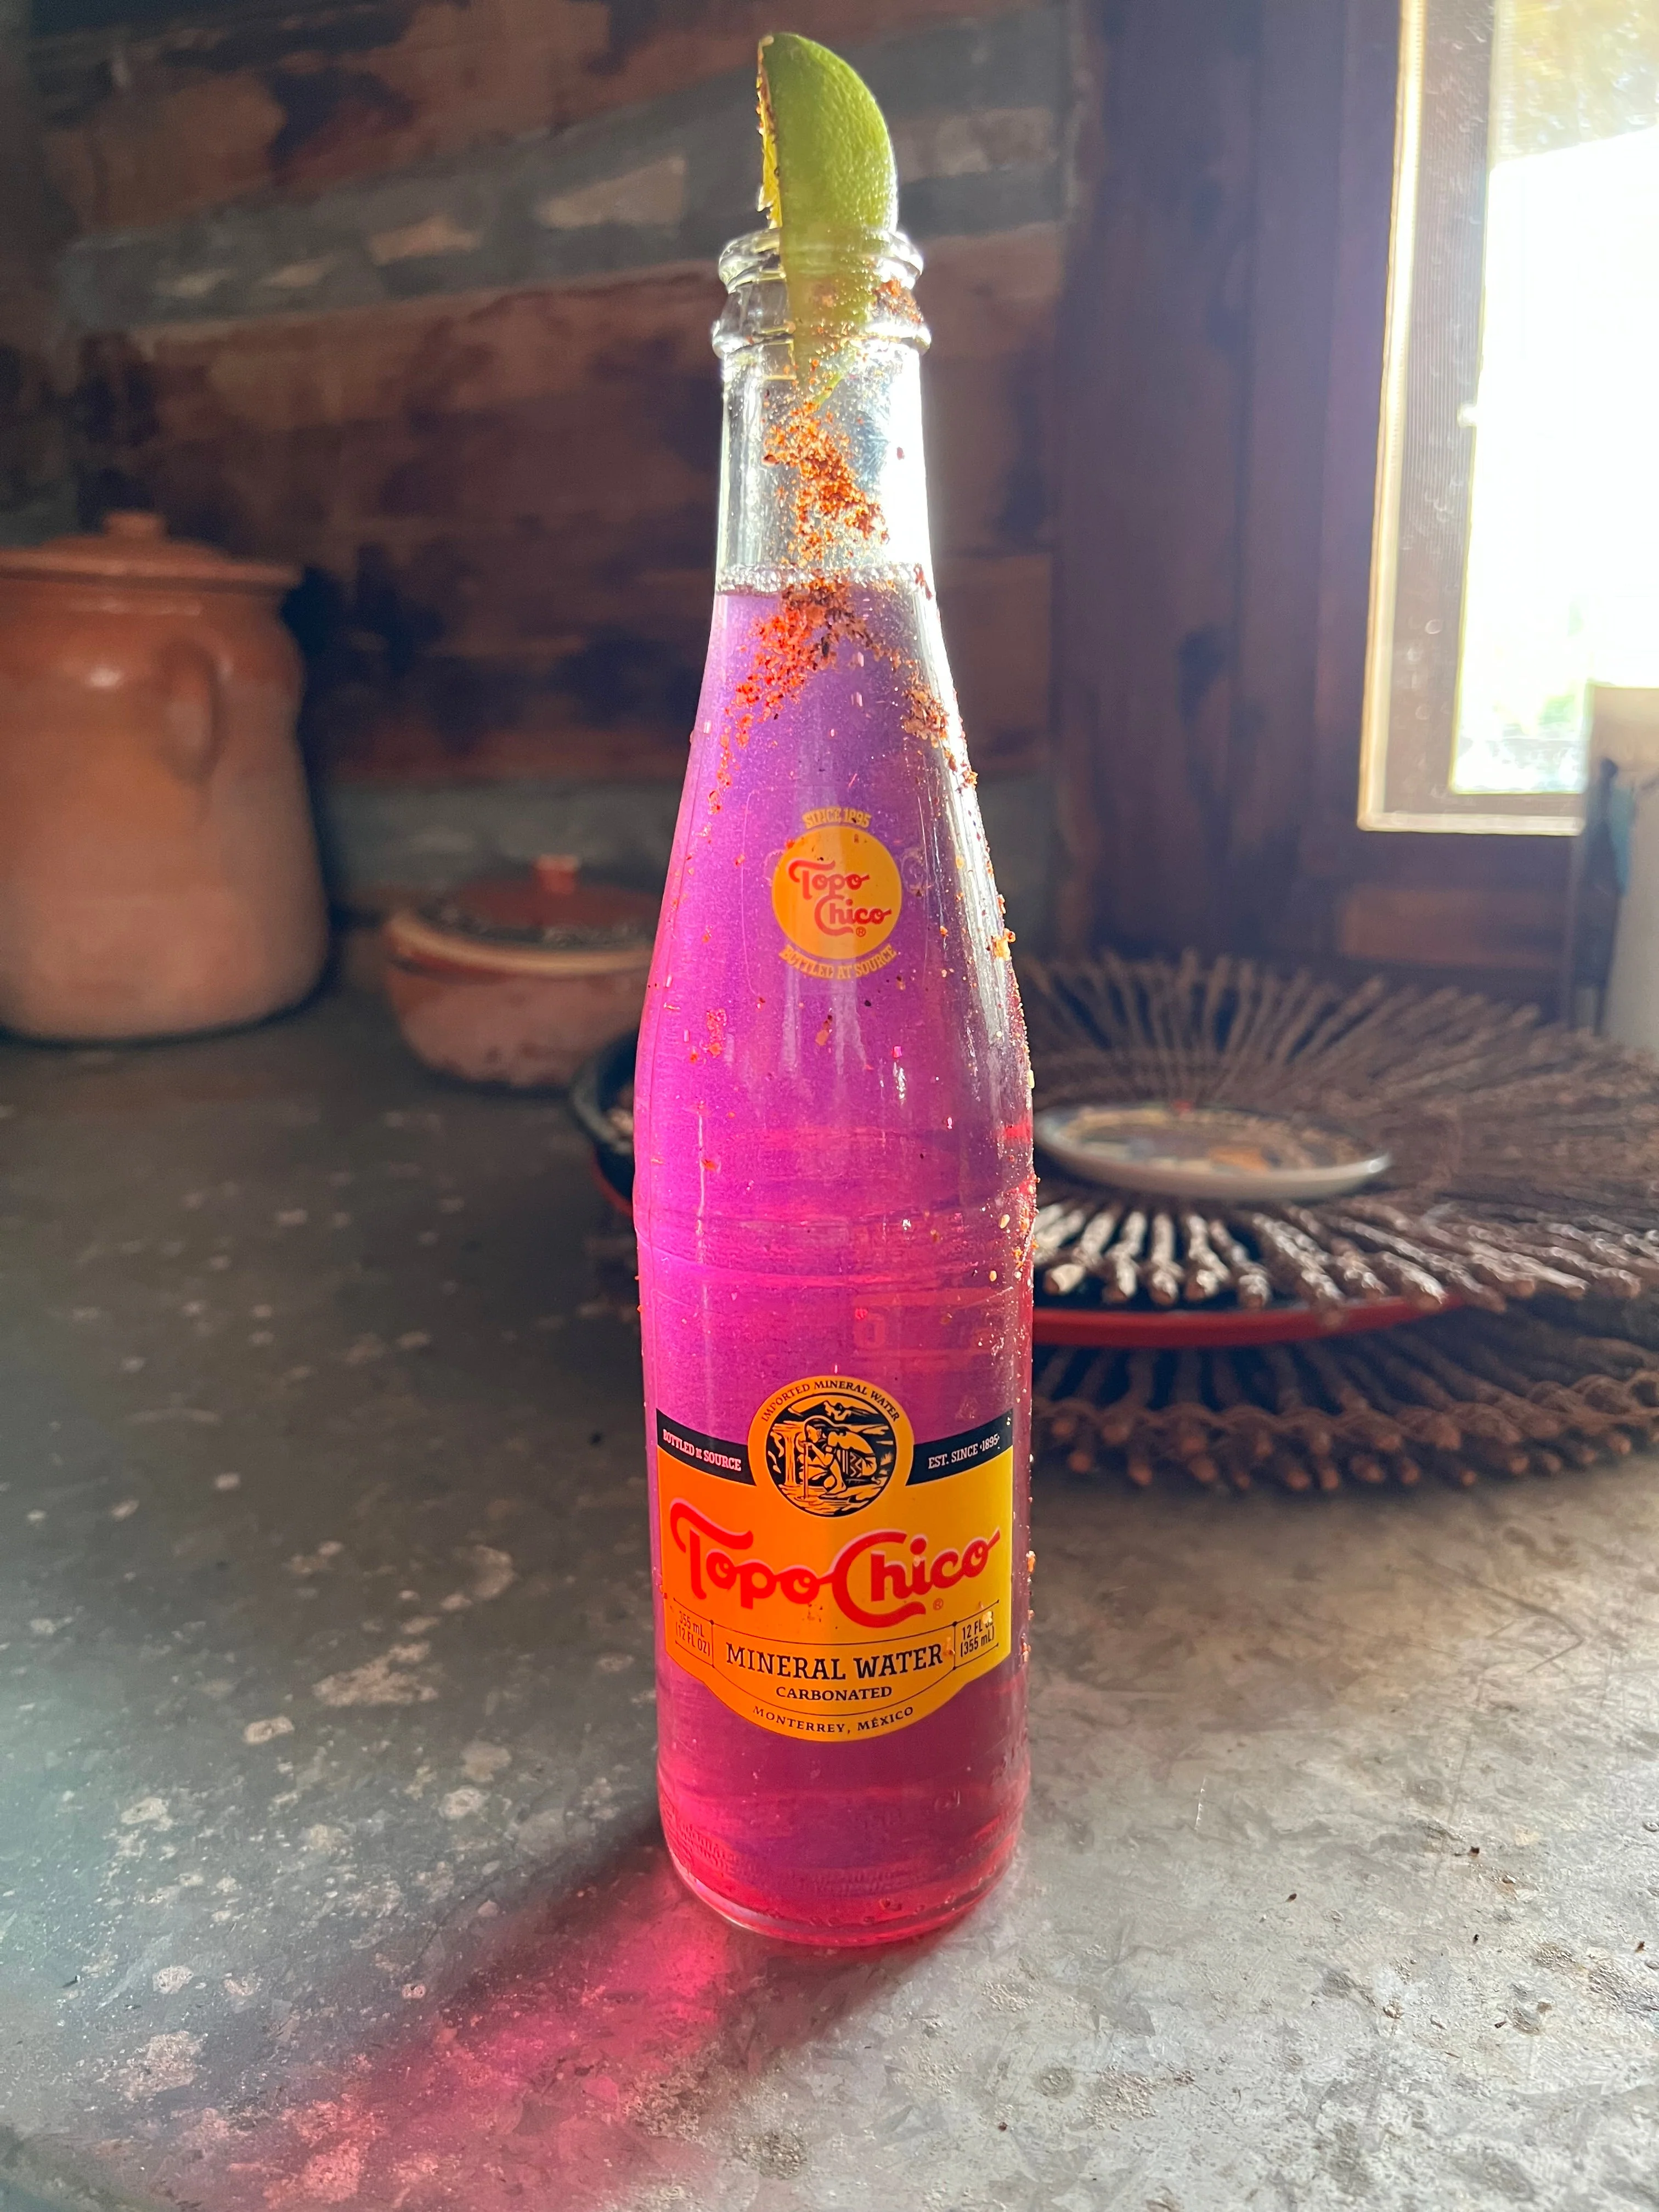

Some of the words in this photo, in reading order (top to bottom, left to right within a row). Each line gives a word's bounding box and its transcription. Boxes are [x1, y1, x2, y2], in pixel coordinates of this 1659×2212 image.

[788, 859, 870, 900] Topo
[814, 893, 892, 936] Chico
[837, 965, 853, 979] AT
[854, 943, 897, 978] SOURCE
[761, 1383, 810, 1423] IMPORTED
[814, 1380, 868, 1396] MINERAL
[870, 1390, 900, 1422] WATER
[663, 1429, 695, 1456] BOTTLED
[703, 1449, 742, 1471] SOURCE
[928, 1453, 950, 1469] EST.
[951, 1443, 978, 1463] SINCE
[669, 1499, 833, 1609] Topo
[831, 1527, 1000, 1628] Chico
[675, 1621, 685, 1641] (12
[687, 1630, 696, 1647] FL
[697, 1638, 710, 1657] OZ)
[679, 1610, 691, 1629] 355
[692, 1623, 705, 1638] mL
[960, 1636, 979, 1657] (355
[980, 1624, 995, 1646] mL)
[962, 1624, 972, 1640] 12
[974, 1619, 983, 1635] FL
[725, 1641, 846, 1680] MINERAL
[853, 1643, 943, 1679] WATER
[775, 1685, 893, 1701] CARBONATED
[857, 1706, 914, 1731] MÉXICO
